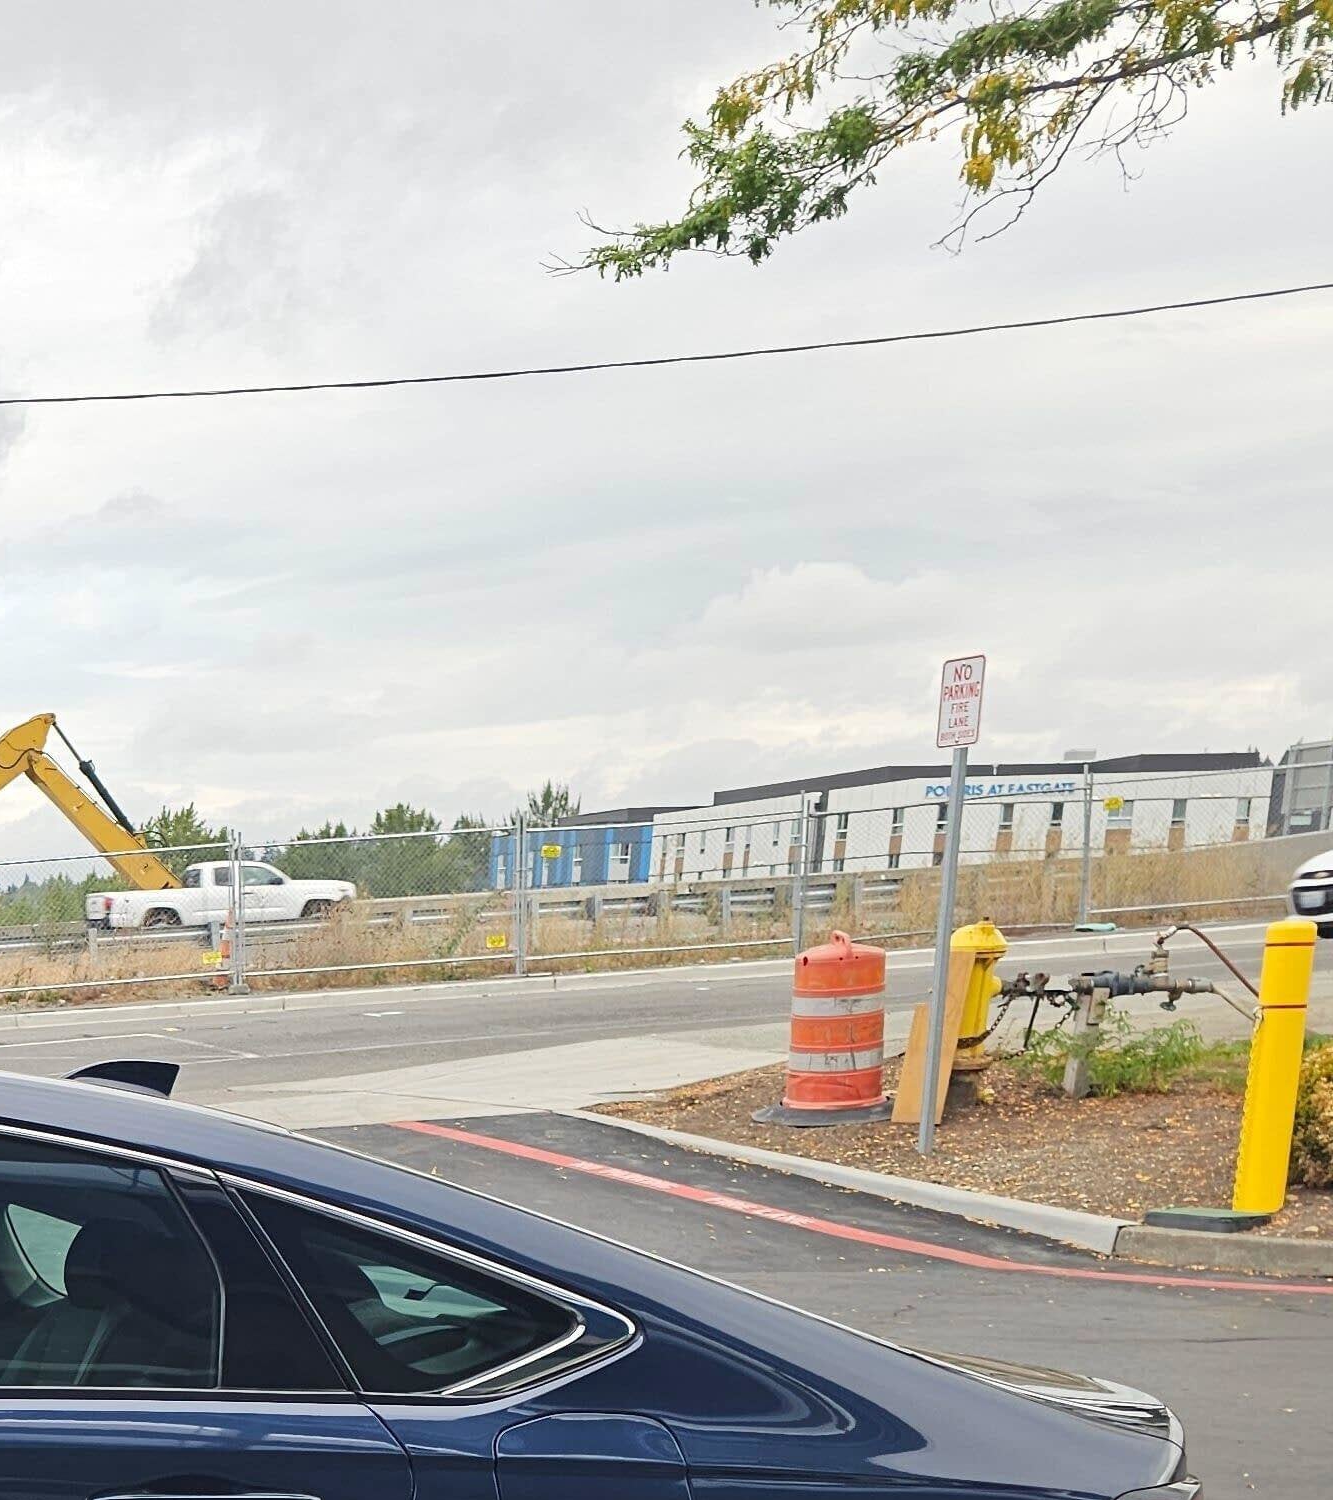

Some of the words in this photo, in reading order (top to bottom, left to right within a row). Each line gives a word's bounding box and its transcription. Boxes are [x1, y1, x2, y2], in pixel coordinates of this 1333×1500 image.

[953, 664, 973, 682] NO
[943, 681, 981, 702] PARKING
[951, 701, 970, 714] FIRE
[948, 715, 970, 729] LANE
[925, 784, 984, 797] PORIS
[988, 784, 1005, 796] AT
